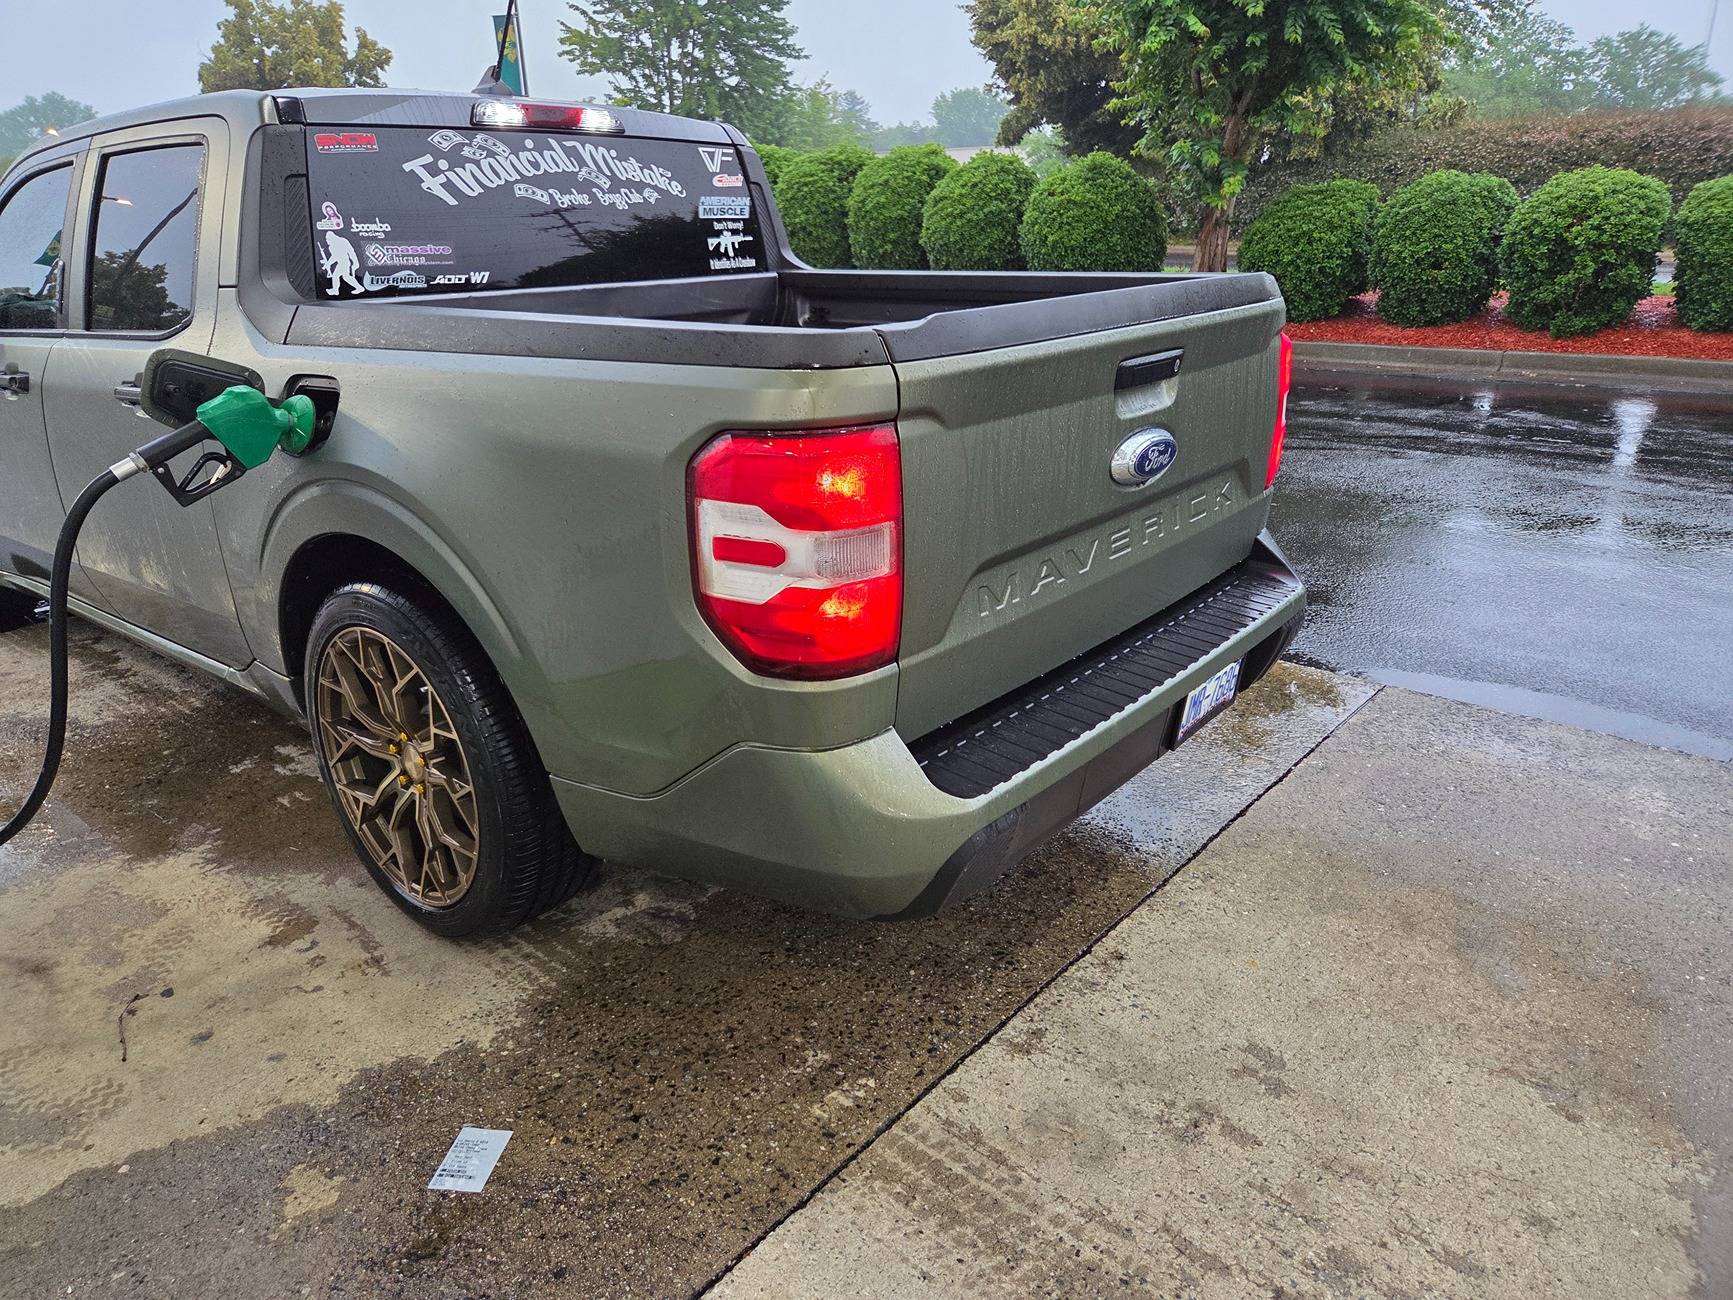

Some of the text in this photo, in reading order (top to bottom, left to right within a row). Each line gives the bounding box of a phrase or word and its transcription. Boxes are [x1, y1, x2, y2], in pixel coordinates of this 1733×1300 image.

[402, 138, 687, 205] Financial Mistake
[548, 188, 592, 207] Broke
[700, 196, 751, 205] AMERICAN
[703, 207, 746, 216] MUSCLE
[350, 217, 392, 232] boomba
[384, 245, 452, 255] massive
[385, 254, 426, 266] Chicago
[370, 275, 425, 285] LIVERNOIS
[1145, 443, 1172, 472] Ford
[979, 481, 1232, 617] MAVERICK
